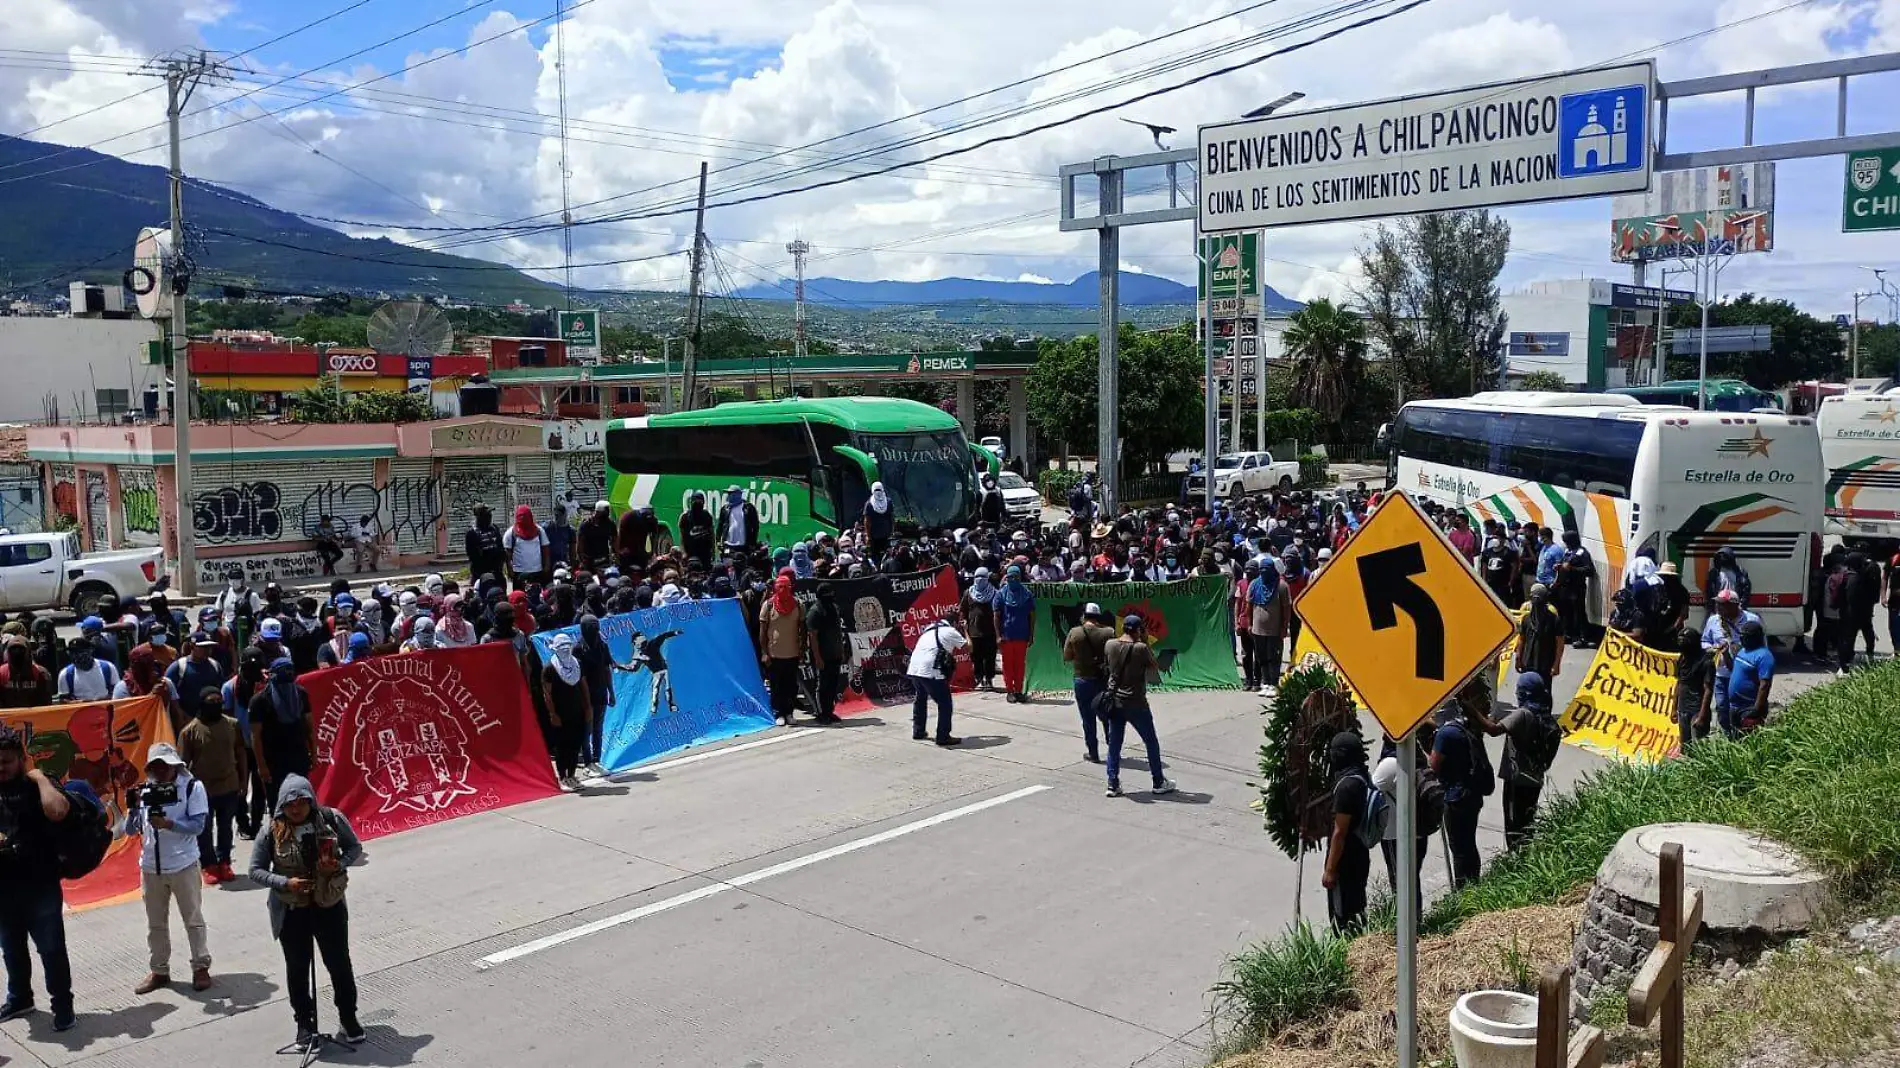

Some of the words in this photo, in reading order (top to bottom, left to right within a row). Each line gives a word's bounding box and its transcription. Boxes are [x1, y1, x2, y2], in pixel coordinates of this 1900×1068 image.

[1207, 126, 1341, 175] BIENVENIDOS
[1353, 123, 1368, 158] A
[1379, 96, 1557, 154] CHILPANCINGO
[1208, 190, 1244, 215] CUNA
[1252, 187, 1269, 211] DE
[1277, 183, 1304, 209] LOS
[1312, 171, 1420, 205] SENTIMIENTOS
[1430, 166, 1449, 193] DE
[1459, 163, 1480, 190] LA
[1491, 153, 1557, 187] NACION
[1857, 171, 1873, 184] 95
[1853, 196, 1900, 216] CHI
[329, 355, 376, 371] OXXO
[410, 361, 430, 370] spin
[924, 357, 968, 370] PEMEX
[1837, 429, 1875, 438] Estrella
[1879, 430, 1891, 438] de
[1685, 469, 1740, 482] Estrella
[1746, 470, 1763, 482] de
[1768, 470, 1794, 482] Oro
[1434, 474, 1457, 492] Estrella
[1467, 481, 1480, 498] Oro
[1075, 583, 1129, 599] VERDAD
[1767, 593, 1779, 605] 15
[316, 677, 361, 766] Escuela
[356, 659, 433, 684] Normal
[437, 664, 502, 736] Rural
[1570, 699, 1617, 735] que
